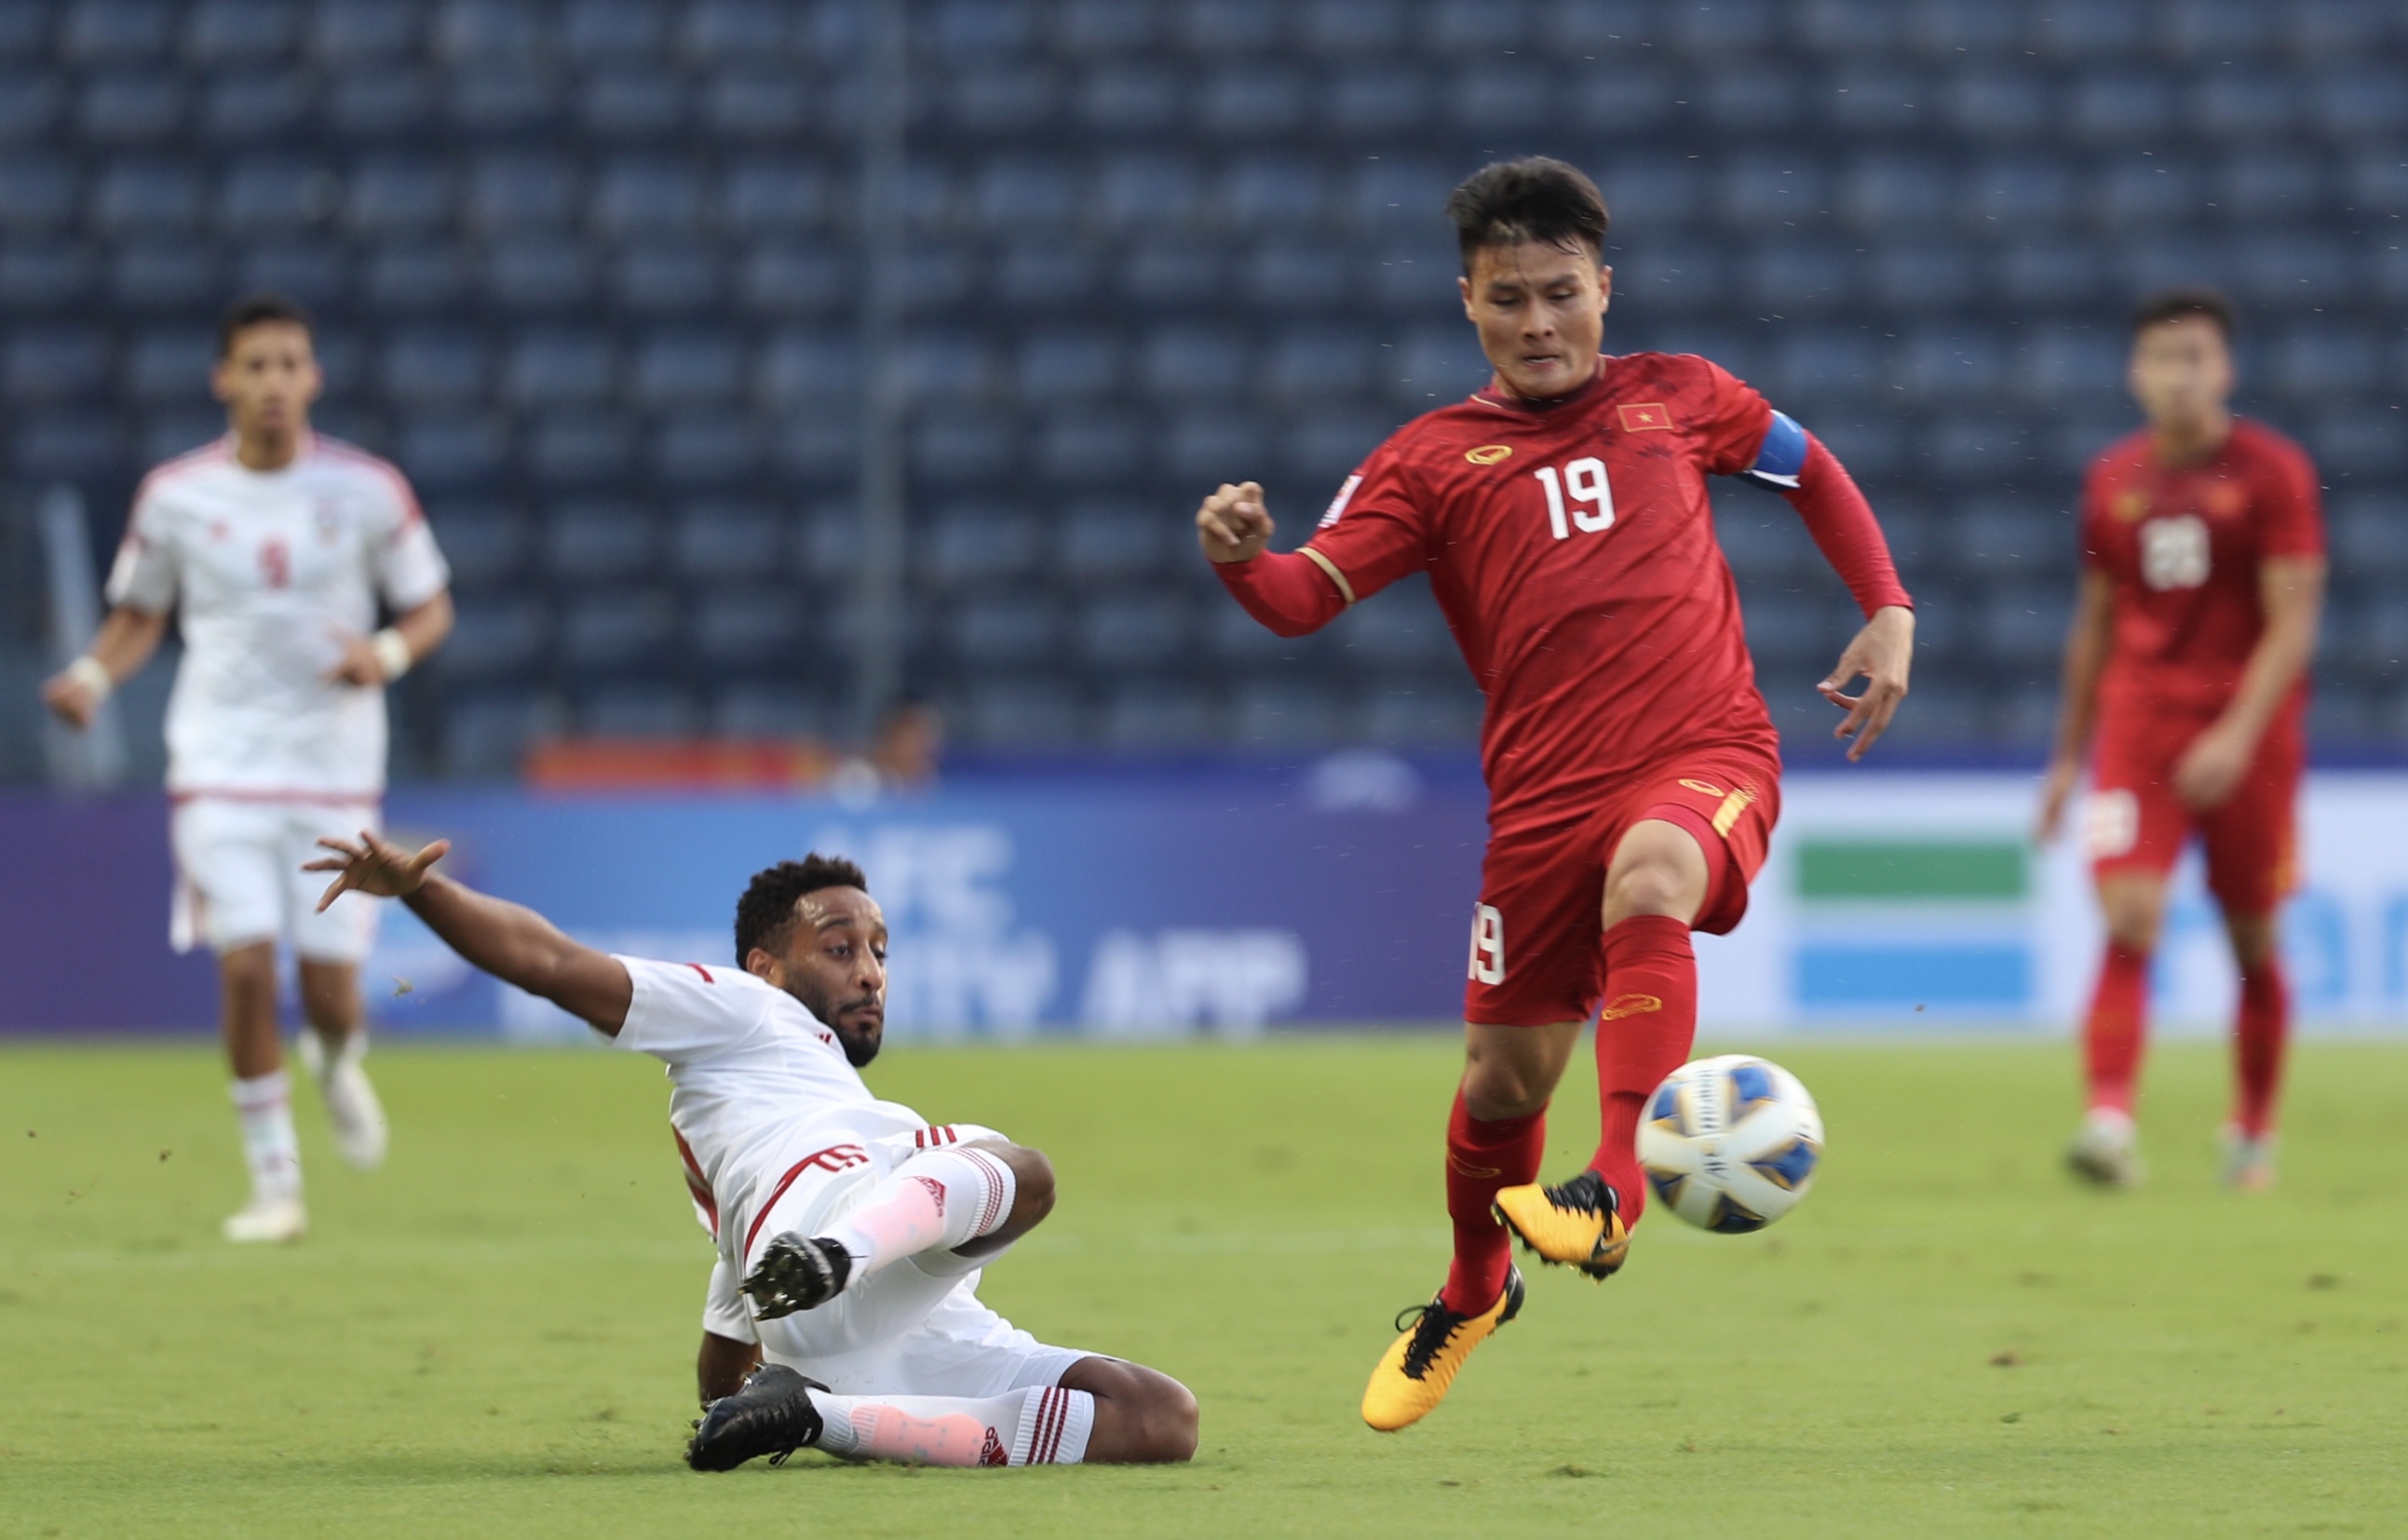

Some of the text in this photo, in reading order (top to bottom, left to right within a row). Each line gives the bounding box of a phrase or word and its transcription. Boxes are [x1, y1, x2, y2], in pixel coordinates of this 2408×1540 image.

[1534, 456, 1616, 540] 19
[1080, 931, 1305, 1038] APP
[1468, 901, 1506, 986] 19
